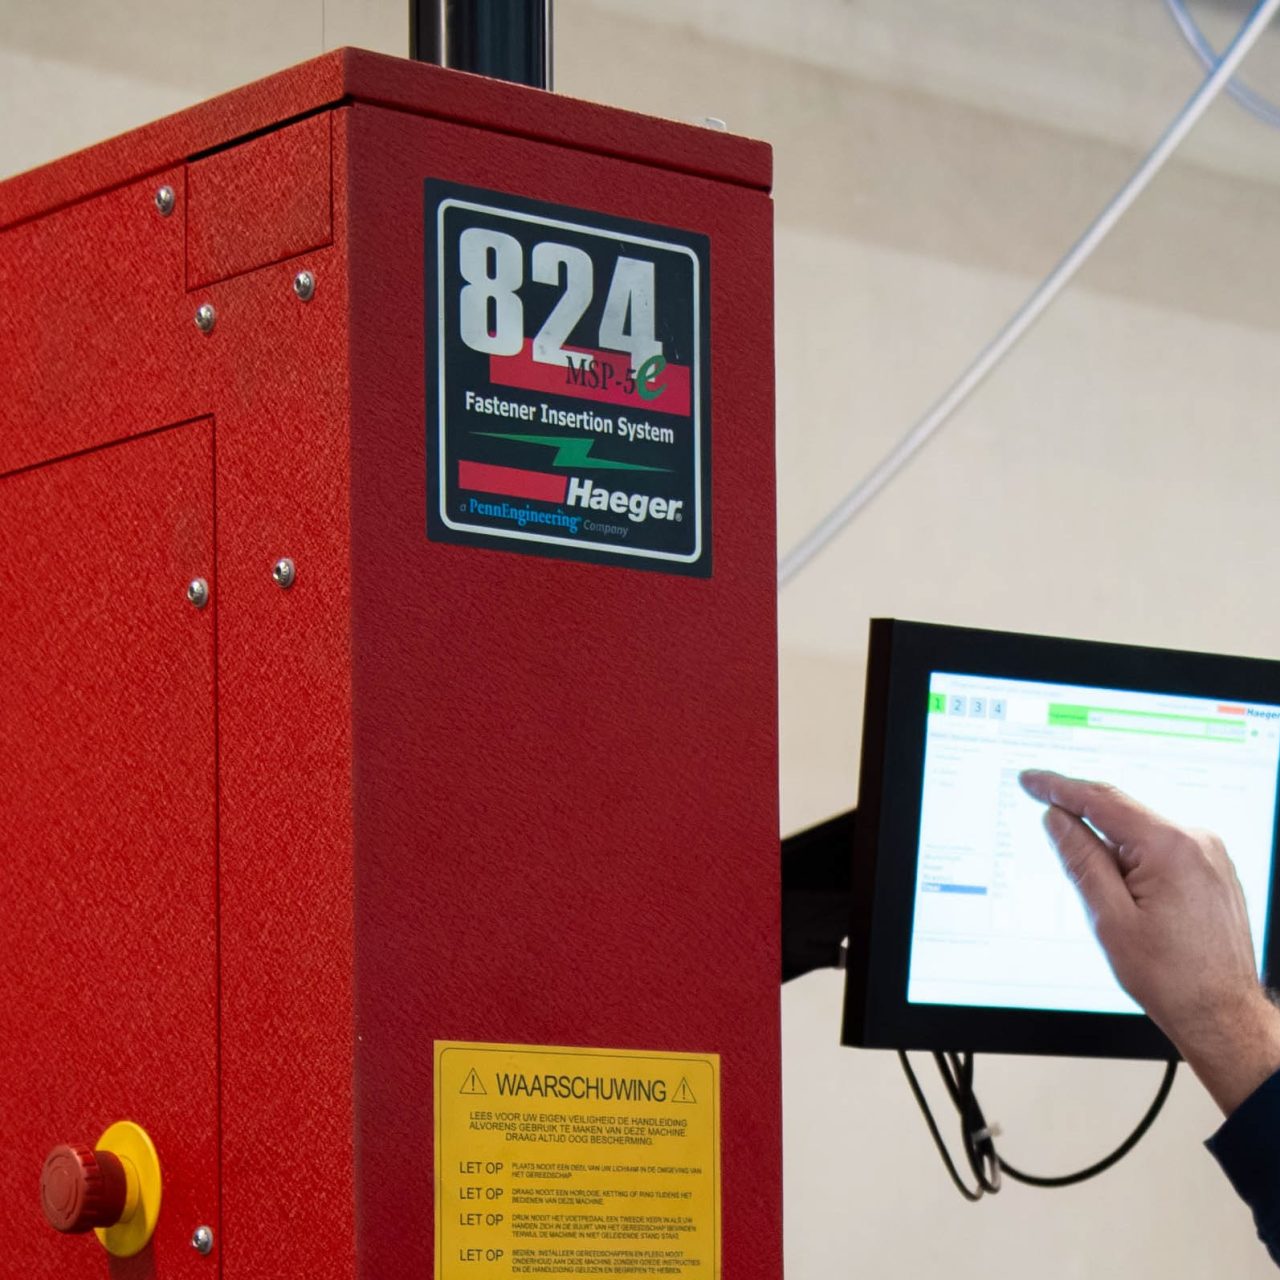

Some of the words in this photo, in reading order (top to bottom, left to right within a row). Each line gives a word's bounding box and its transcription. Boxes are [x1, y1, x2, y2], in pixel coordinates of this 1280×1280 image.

[460, 227, 663, 382] 824
[465, 391, 536, 421] Fastener
[540, 404, 613, 434] Insertion
[617, 417, 674, 444] System
[583, 519, 629, 537] Company
[954, 699, 962, 711] 2
[975, 701, 982, 713] 3
[994, 703, 1001, 714] 4
[496, 1072, 667, 1102] WAARSCHUWING
[459, 1161, 482, 1174] LET
[485, 1161, 504, 1175] OP
[459, 1187, 482, 1200] LET
[485, 1187, 504, 1201] OP
[459, 1213, 482, 1226] LET
[485, 1213, 504, 1227] OP
[459, 1249, 482, 1262] LET
[485, 1249, 504, 1263] OP
